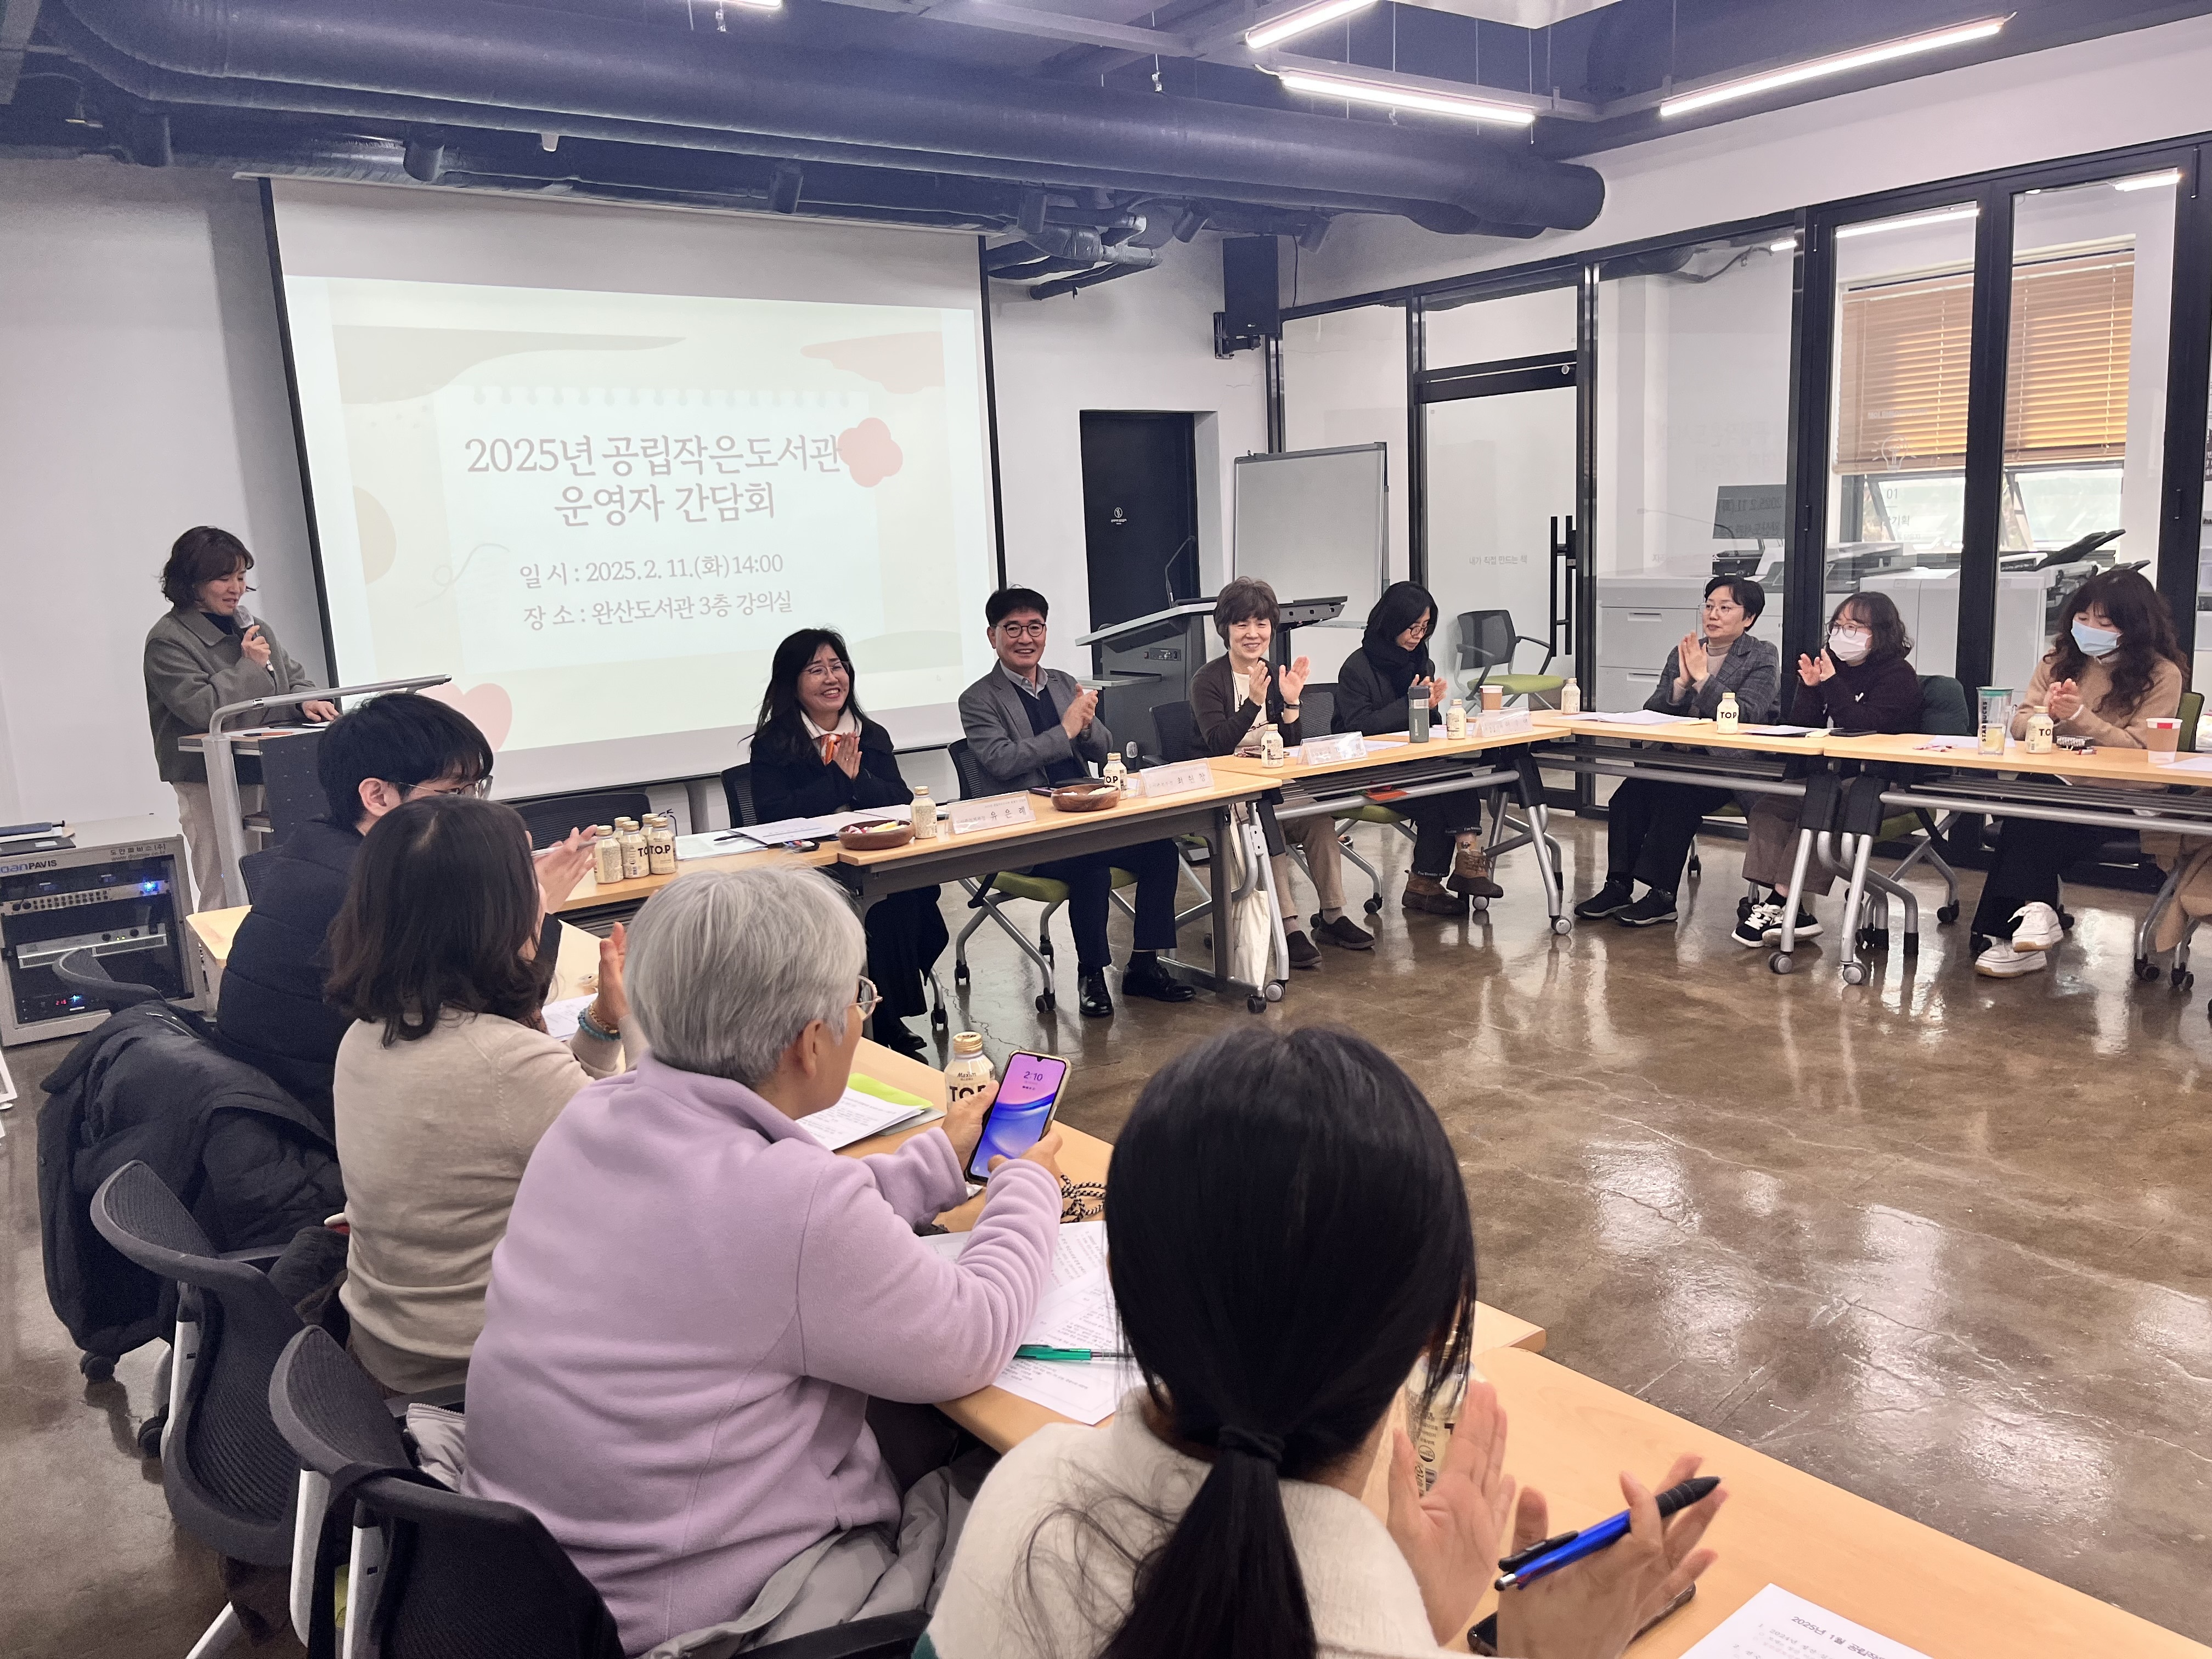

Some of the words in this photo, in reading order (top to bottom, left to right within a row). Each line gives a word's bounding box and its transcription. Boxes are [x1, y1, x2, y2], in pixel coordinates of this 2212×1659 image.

[465, 435, 596, 477] 2025년
[602, 434, 843, 477] 공립작은도서관
[1887, 488, 1898, 499] 01
[554, 484, 665, 527] 운영자
[676, 482, 774, 523] 간담회
[1469, 556, 1481, 565] 내가
[1484, 556, 1496, 565] 직접
[1498, 555, 1518, 565] 만드는
[591, 596, 695, 625] 완산도서관
[699, 594, 732, 618] 3층
[736, 590, 793, 616] 강의실
[1, 860, 57, 873] oanPAVIS
[1023, 1071, 1043, 1082] 2:10
[1791, 1616, 1826, 1635] 2025년
